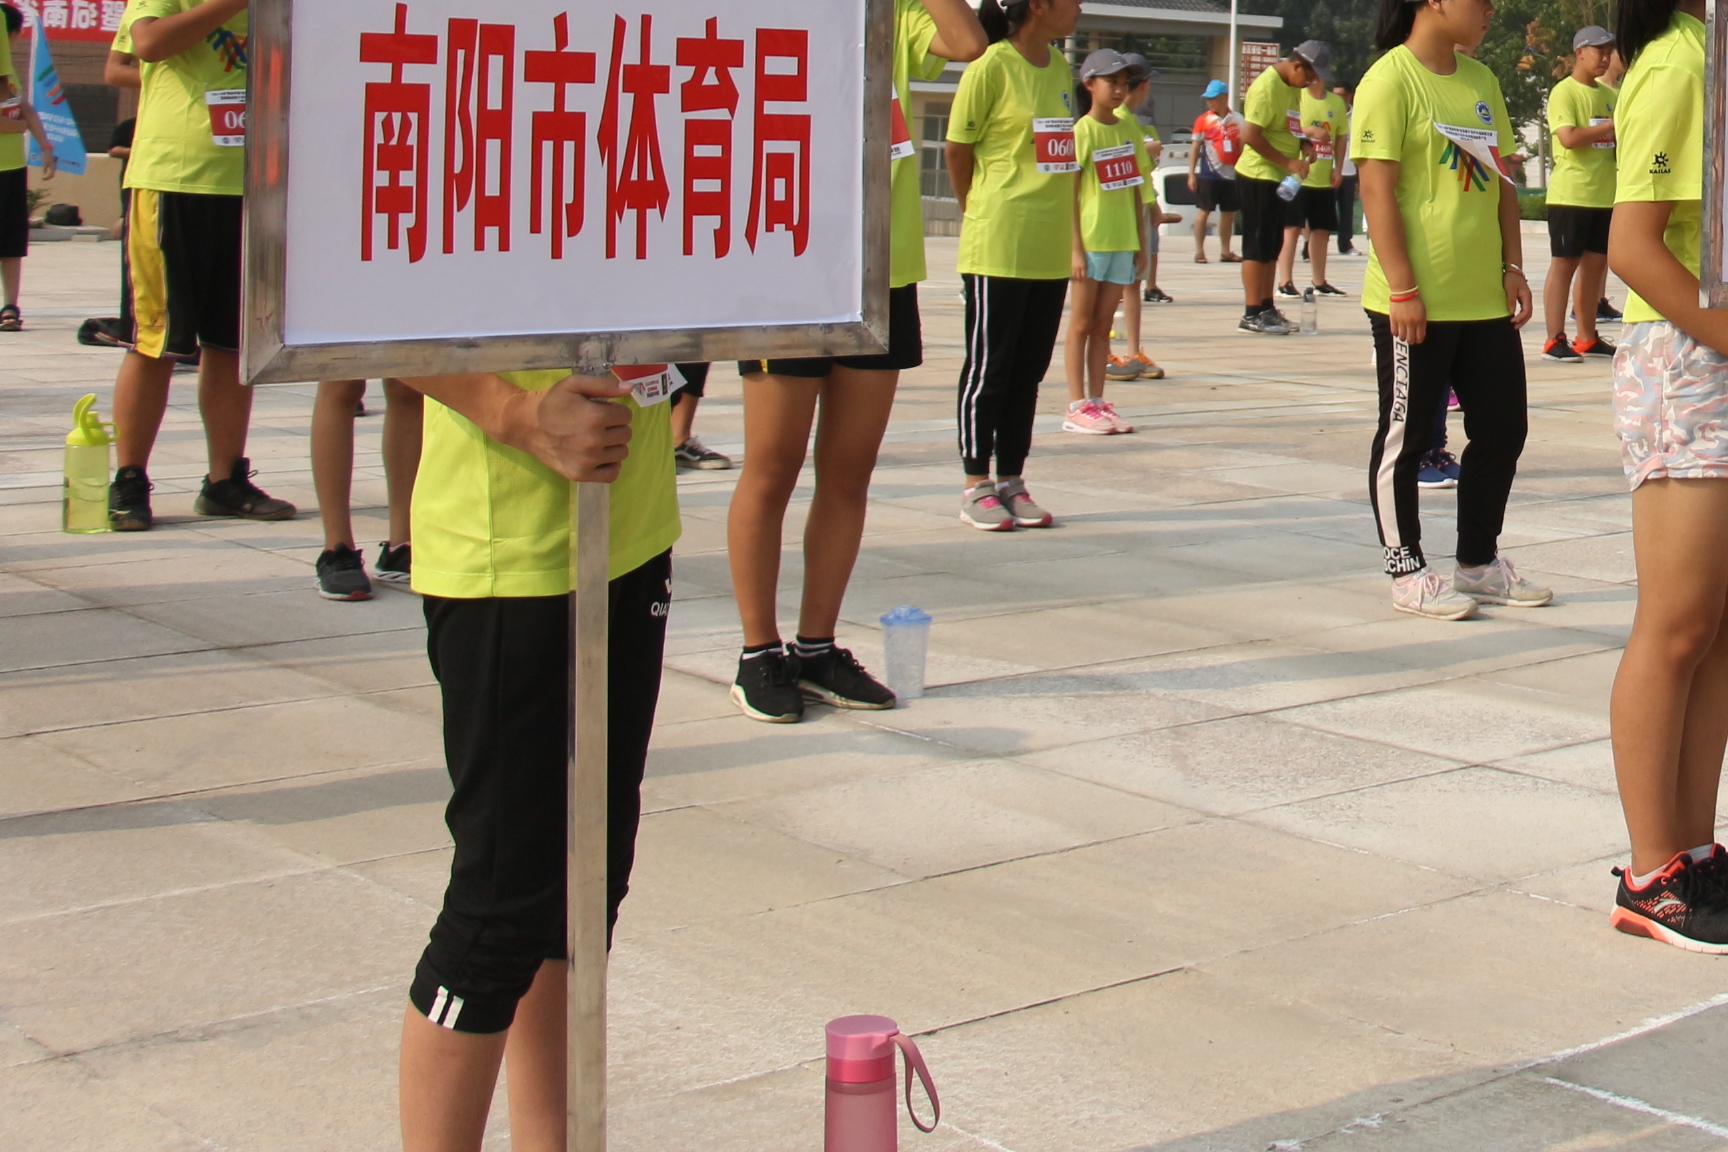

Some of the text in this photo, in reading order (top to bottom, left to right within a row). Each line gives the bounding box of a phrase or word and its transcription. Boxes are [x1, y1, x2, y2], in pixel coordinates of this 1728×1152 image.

[224, 110, 246, 129] 06
[358, 2, 813, 264] 南阳市体育局
[1105, 160, 1133, 178] 1110
[1391, 340, 1409, 423] ENCIAGA
[651, 601, 669, 617] QIA
